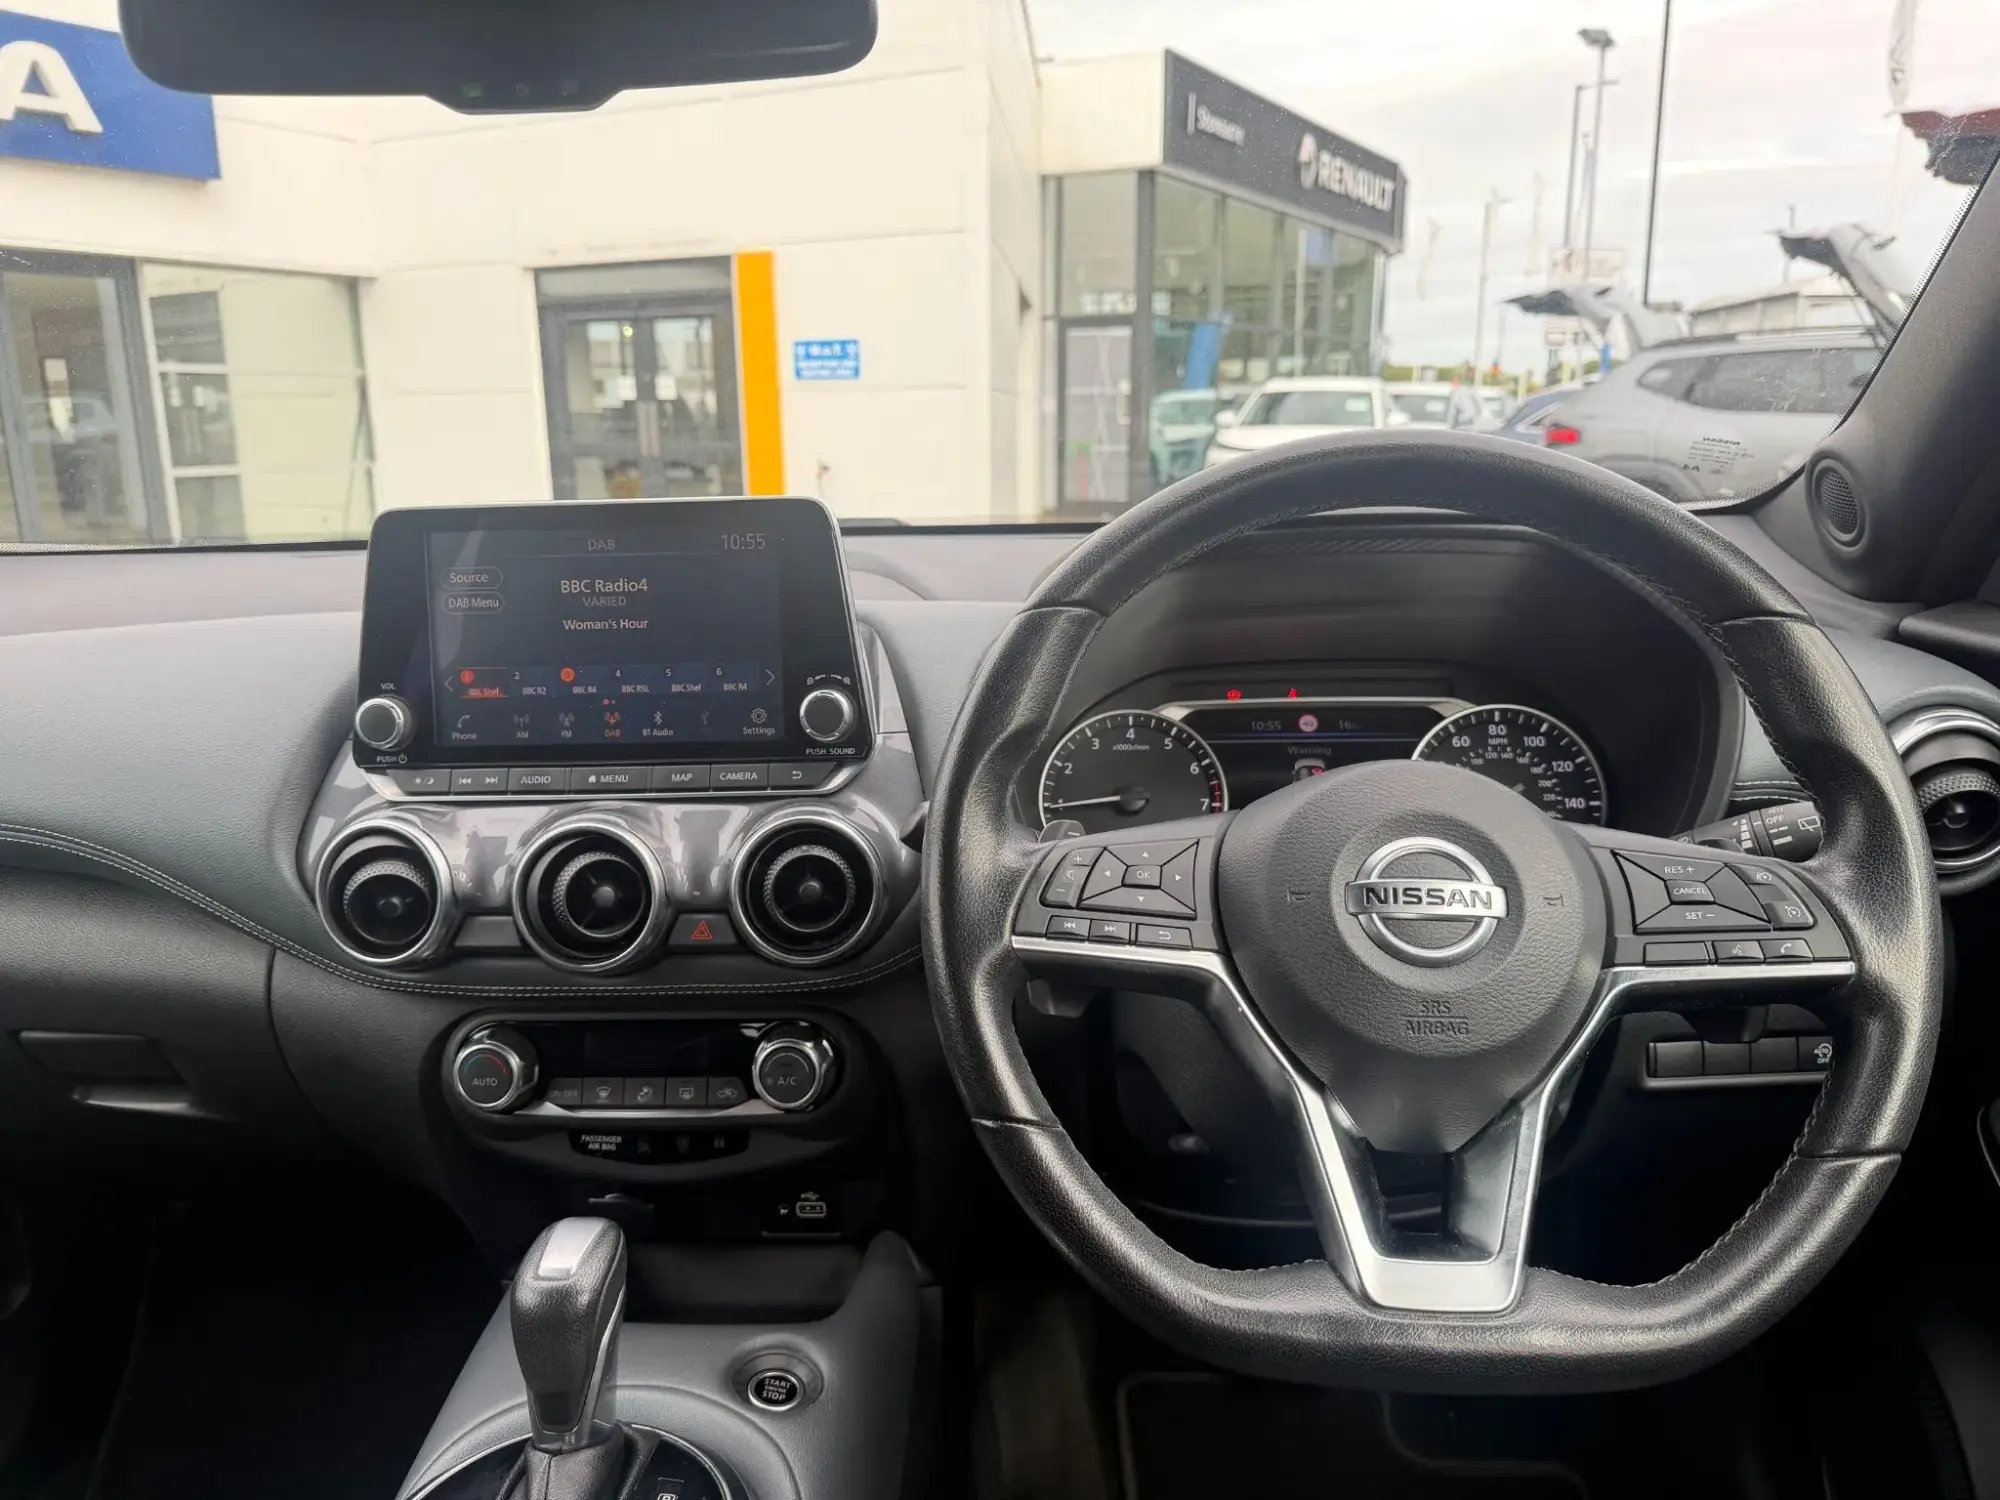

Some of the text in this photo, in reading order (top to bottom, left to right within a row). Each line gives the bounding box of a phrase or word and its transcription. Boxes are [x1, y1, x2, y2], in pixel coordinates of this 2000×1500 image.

[587, 539, 616, 551] DAB
[721, 533, 766, 550] 10:55
[450, 573, 488, 583] Source
[560, 578, 648, 593] BBC Radio4
[449, 598, 499, 608] DAB Menu
[582, 596, 626, 607] VARIED
[563, 618, 648, 630] Woman's Hour
[514, 672, 520, 680] 2
[615, 670, 621, 678] 4
[666, 669, 672, 677] 5
[716, 667, 723, 676] 6
[380, 682, 396, 691] VOL
[522, 686, 547, 695] BBC R2
[573, 686, 585, 694] BBC
[621, 685, 635, 693] BBC
[671, 684, 685, 692] BBC
[723, 682, 748, 691] BBC R4
[1251, 721, 1282, 731] 10:55
[1488, 725, 1507, 735] 80
[516, 731, 529, 739] AM
[604, 729, 621, 738] DAB
[653, 728, 674, 737] Audio
[743, 726, 776, 736] Settings
[1126, 728, 1135, 740] 4
[452, 732, 478, 740] Phone
[1091, 738, 1100, 750] 3
[1164, 738, 1173, 750] 5
[1452, 736, 1471, 747] 60
[1523, 736, 1546, 747] 100
[1288, 746, 1332, 755] Warning
[376, 755, 397, 763] PUSH
[1064, 763, 1073, 774] 2
[1190, 763, 1200, 775] 6
[1552, 761, 1574, 772] 120
[520, 776, 551, 784] AUDIO
[600, 775, 629, 783] MENU
[671, 773, 693, 781] MAP
[720, 772, 758, 780] CAMERA
[1200, 799, 1209, 811] 7
[1564, 798, 1585, 809] 140
[1766, 815, 1784, 824] OFF
[1664, 866, 1684, 874] RES
[1136, 871, 1150, 879] OK
[1673, 887, 1705, 895] CANCEL
[1363, 887, 1492, 910] NISSAN
[1685, 912, 1703, 920] SET
[1419, 1001, 1450, 1014] SRS
[1404, 1021, 1468, 1035] AIRBAG
[472, 1077, 498, 1086] AUTO
[777, 1076, 797, 1086] A/C
[581, 1134, 622, 1143] PASSENGER
[764, 1378, 791, 1389] START
[763, 1391, 785, 1401] STOP
